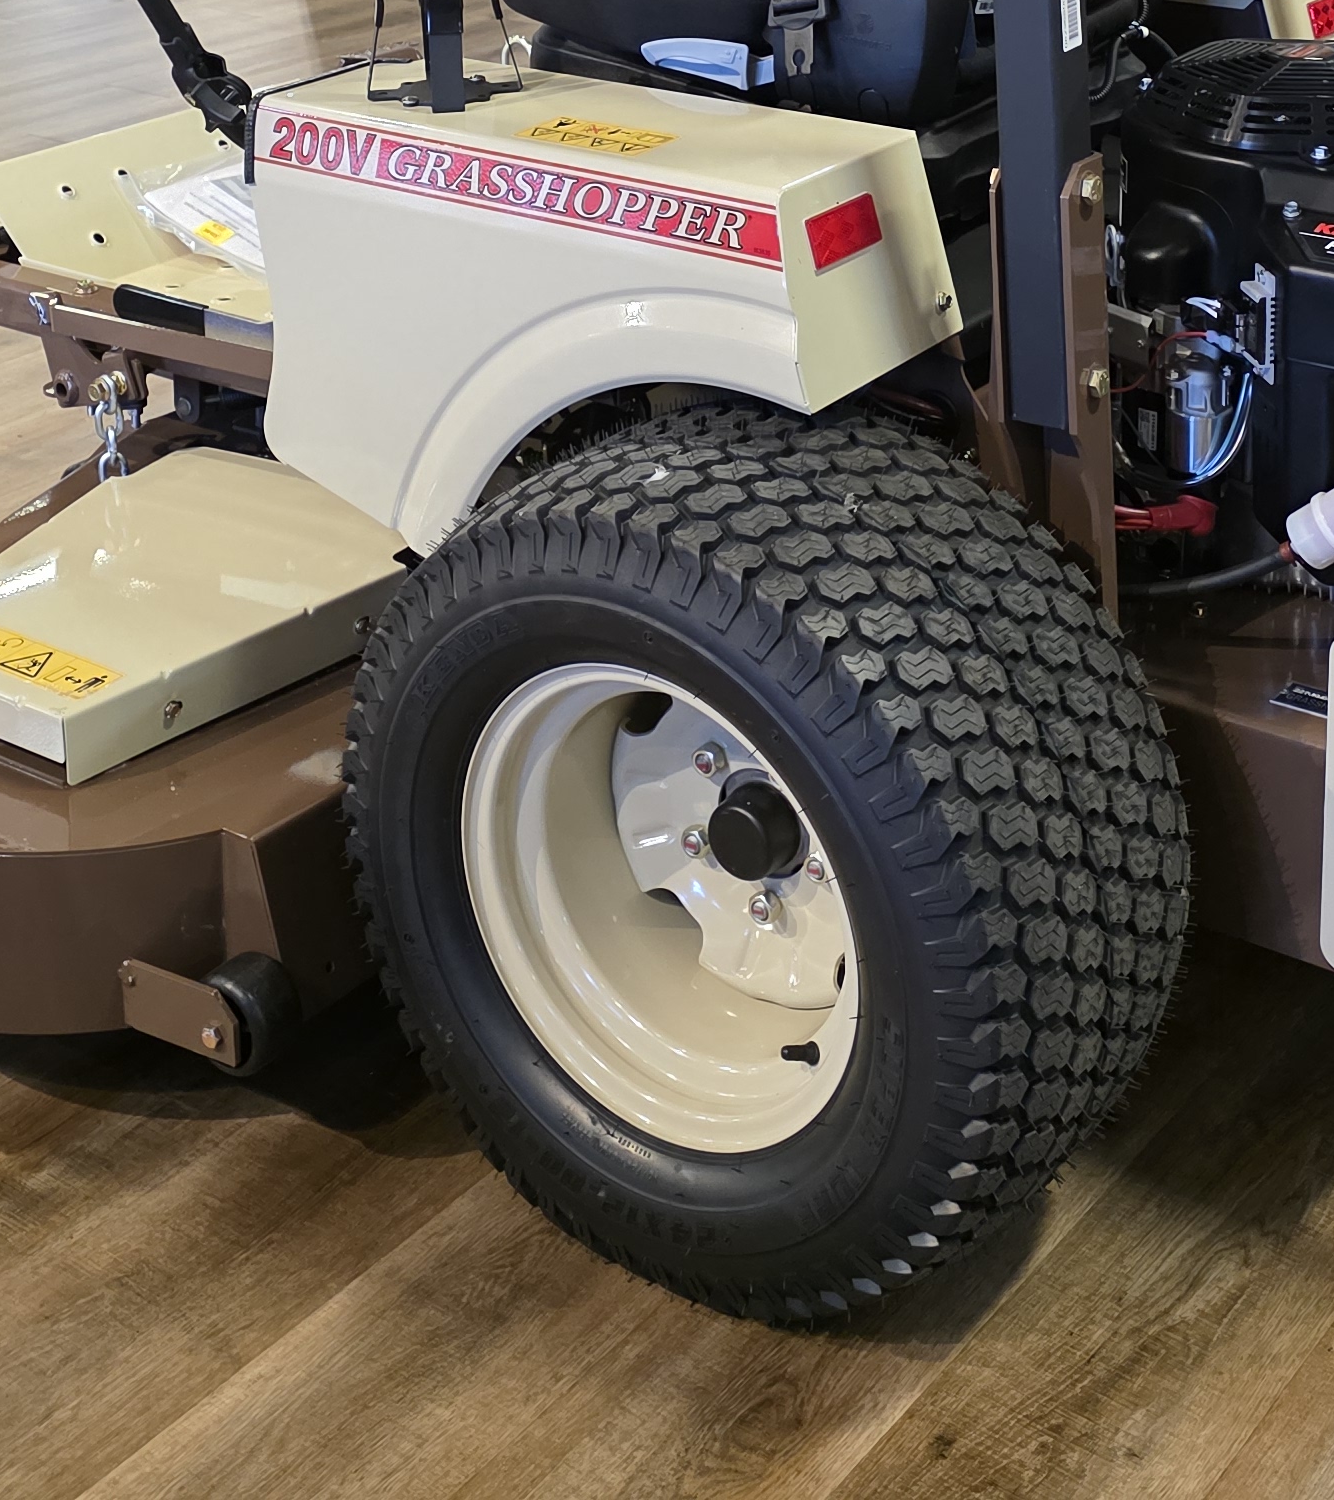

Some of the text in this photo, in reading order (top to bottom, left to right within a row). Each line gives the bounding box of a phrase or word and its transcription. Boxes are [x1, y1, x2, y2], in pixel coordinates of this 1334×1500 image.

[269, 117, 745, 251] 200V GRASSHOPPER
[411, 610, 525, 709] KENDA
